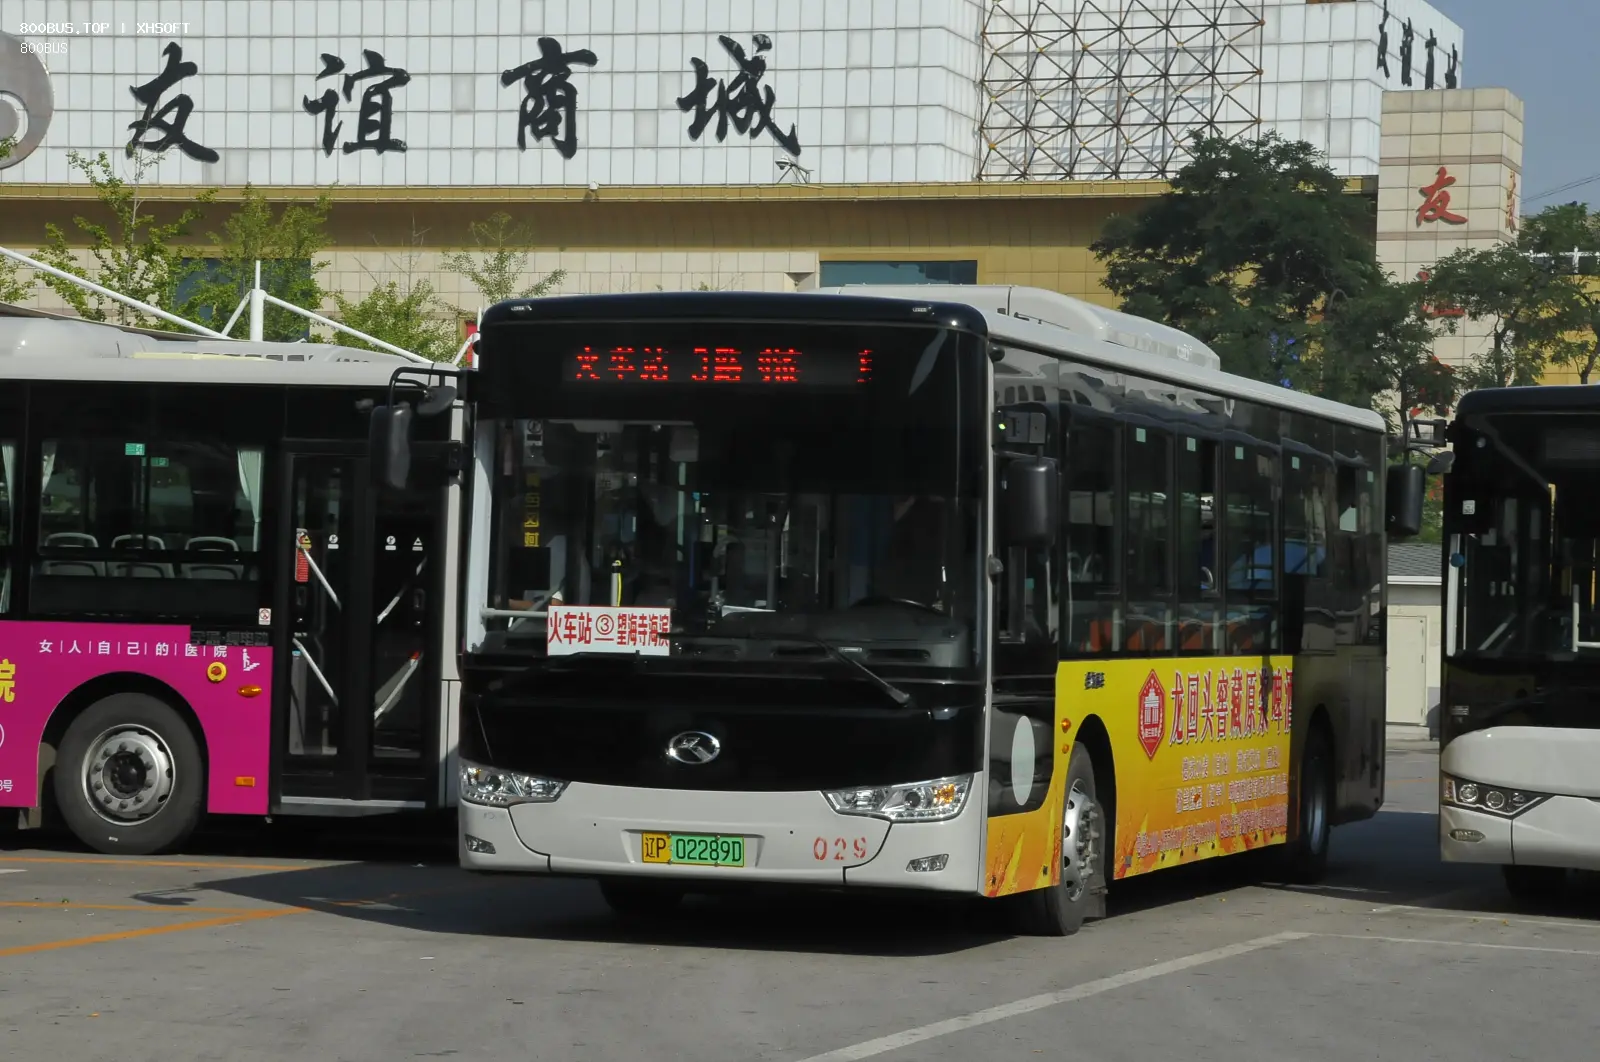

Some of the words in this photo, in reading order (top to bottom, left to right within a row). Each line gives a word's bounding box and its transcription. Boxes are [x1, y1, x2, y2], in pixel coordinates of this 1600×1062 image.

[126, 33, 802, 162] 友谊商城
[548, 611, 592, 645] 火车站
[645, 837, 667, 859] 辽P
[675, 838, 742, 863] 02289D
[813, 836, 867, 861] 029
